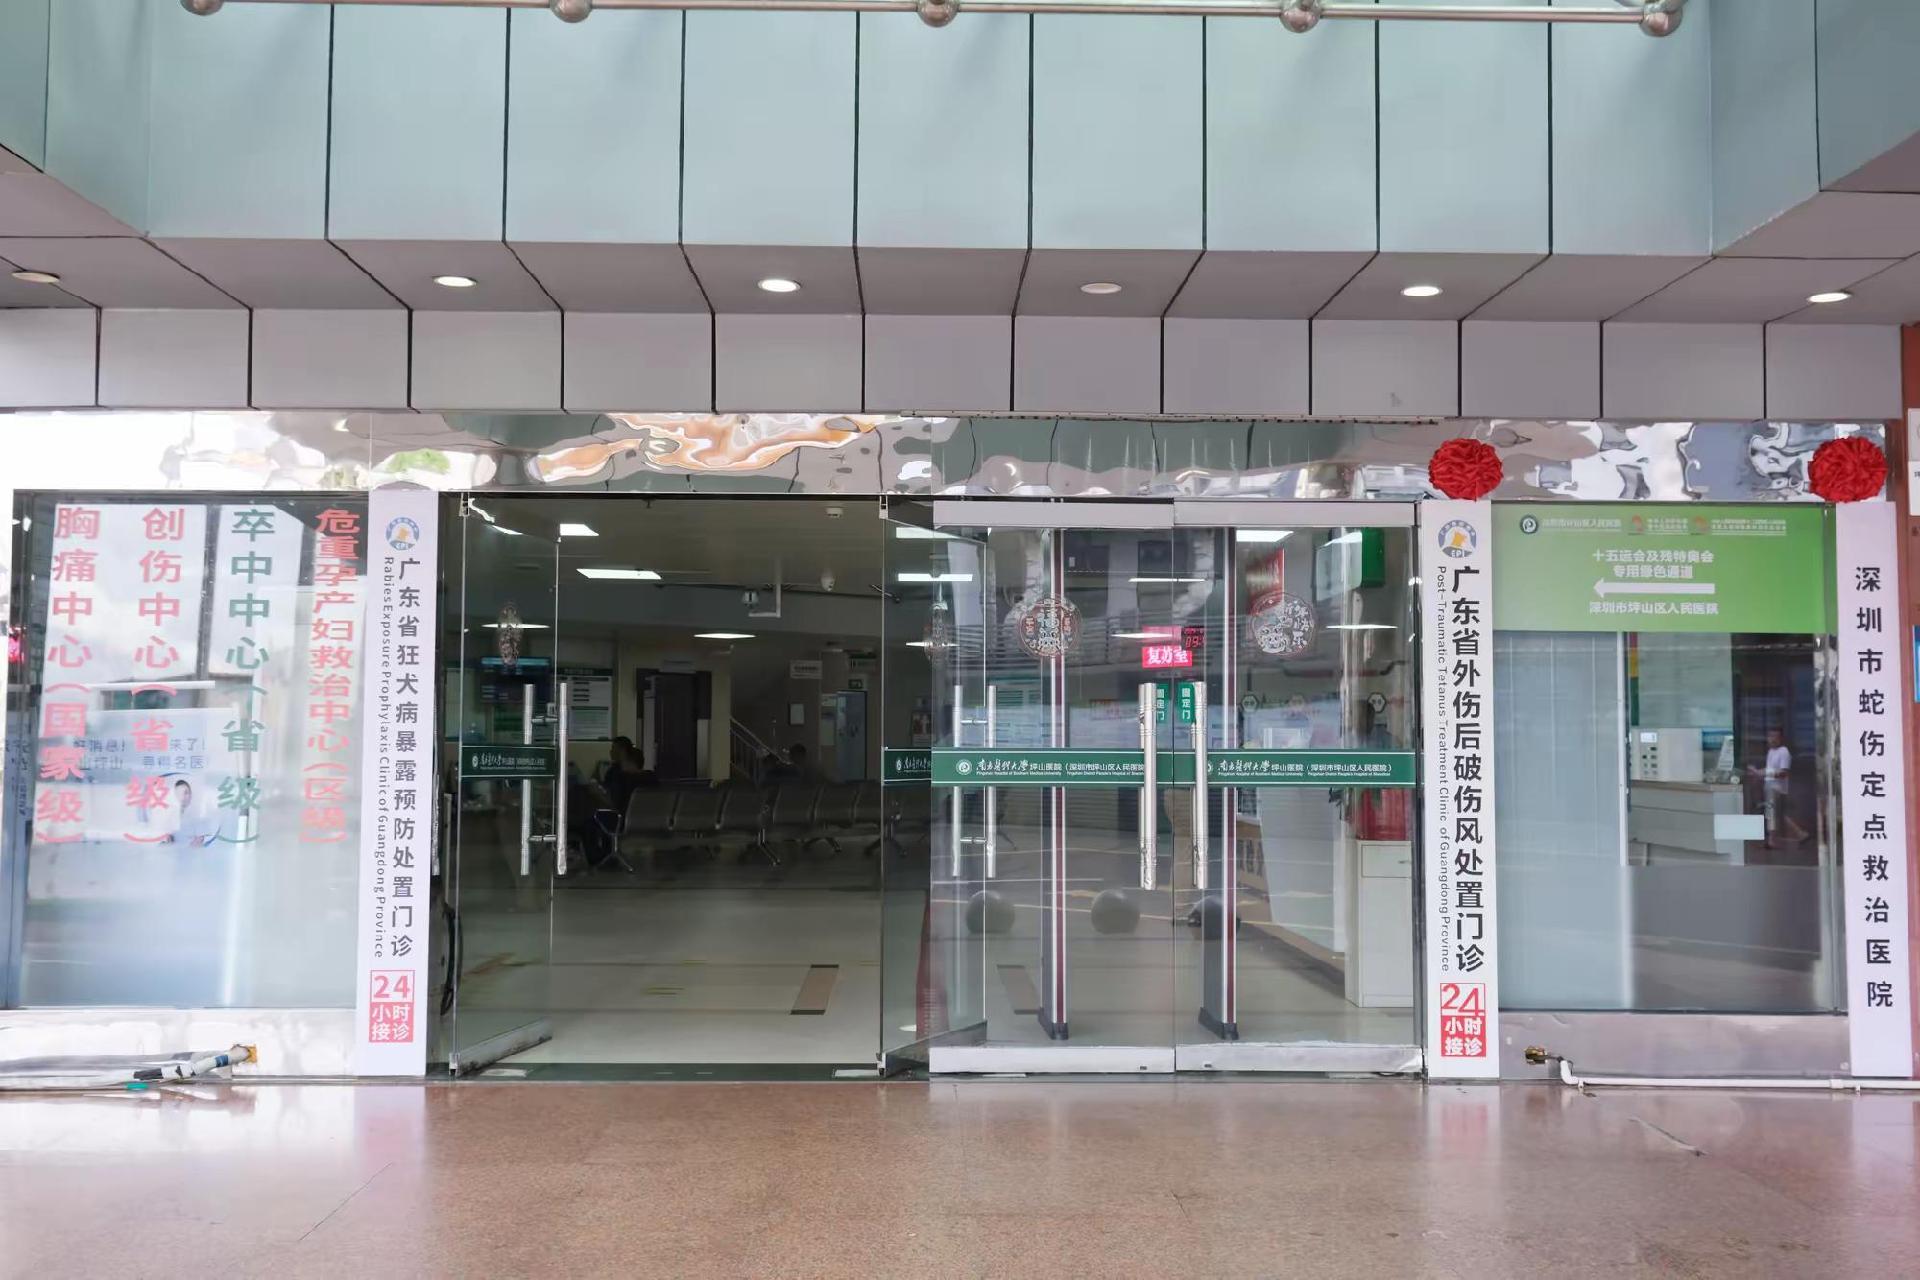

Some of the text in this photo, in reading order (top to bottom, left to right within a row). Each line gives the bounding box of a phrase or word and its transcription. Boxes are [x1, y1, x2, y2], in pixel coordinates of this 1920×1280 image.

[384, 556, 395, 602] Rabies
[380, 605, 393, 668] Exposure
[378, 671, 391, 753] Prophylaxis
[390, 558, 421, 957] 广东省狂犬病暴露预防处置门诊
[1439, 720, 1448, 783] Treatment
[1452, 566, 1484, 973] 广东省外伤后破伤风处置门诊
[379, 756, 391, 794] Clinic
[1855, 566, 1893, 1008] 深圳市蛇伤定点救治医院
[1439, 787, 1450, 821] Clinic
[374, 815, 388, 893] Guangdong
[374, 896, 386, 957] Province
[373, 976, 410, 998] 24
[1441, 983, 1485, 1016] 24
[371, 1004, 410, 1022] 小时
[371, 1023, 409, 1041] 接诊
[1445, 1017, 1482, 1035] 小时
[1444, 1037, 1482, 1056] 接诊
